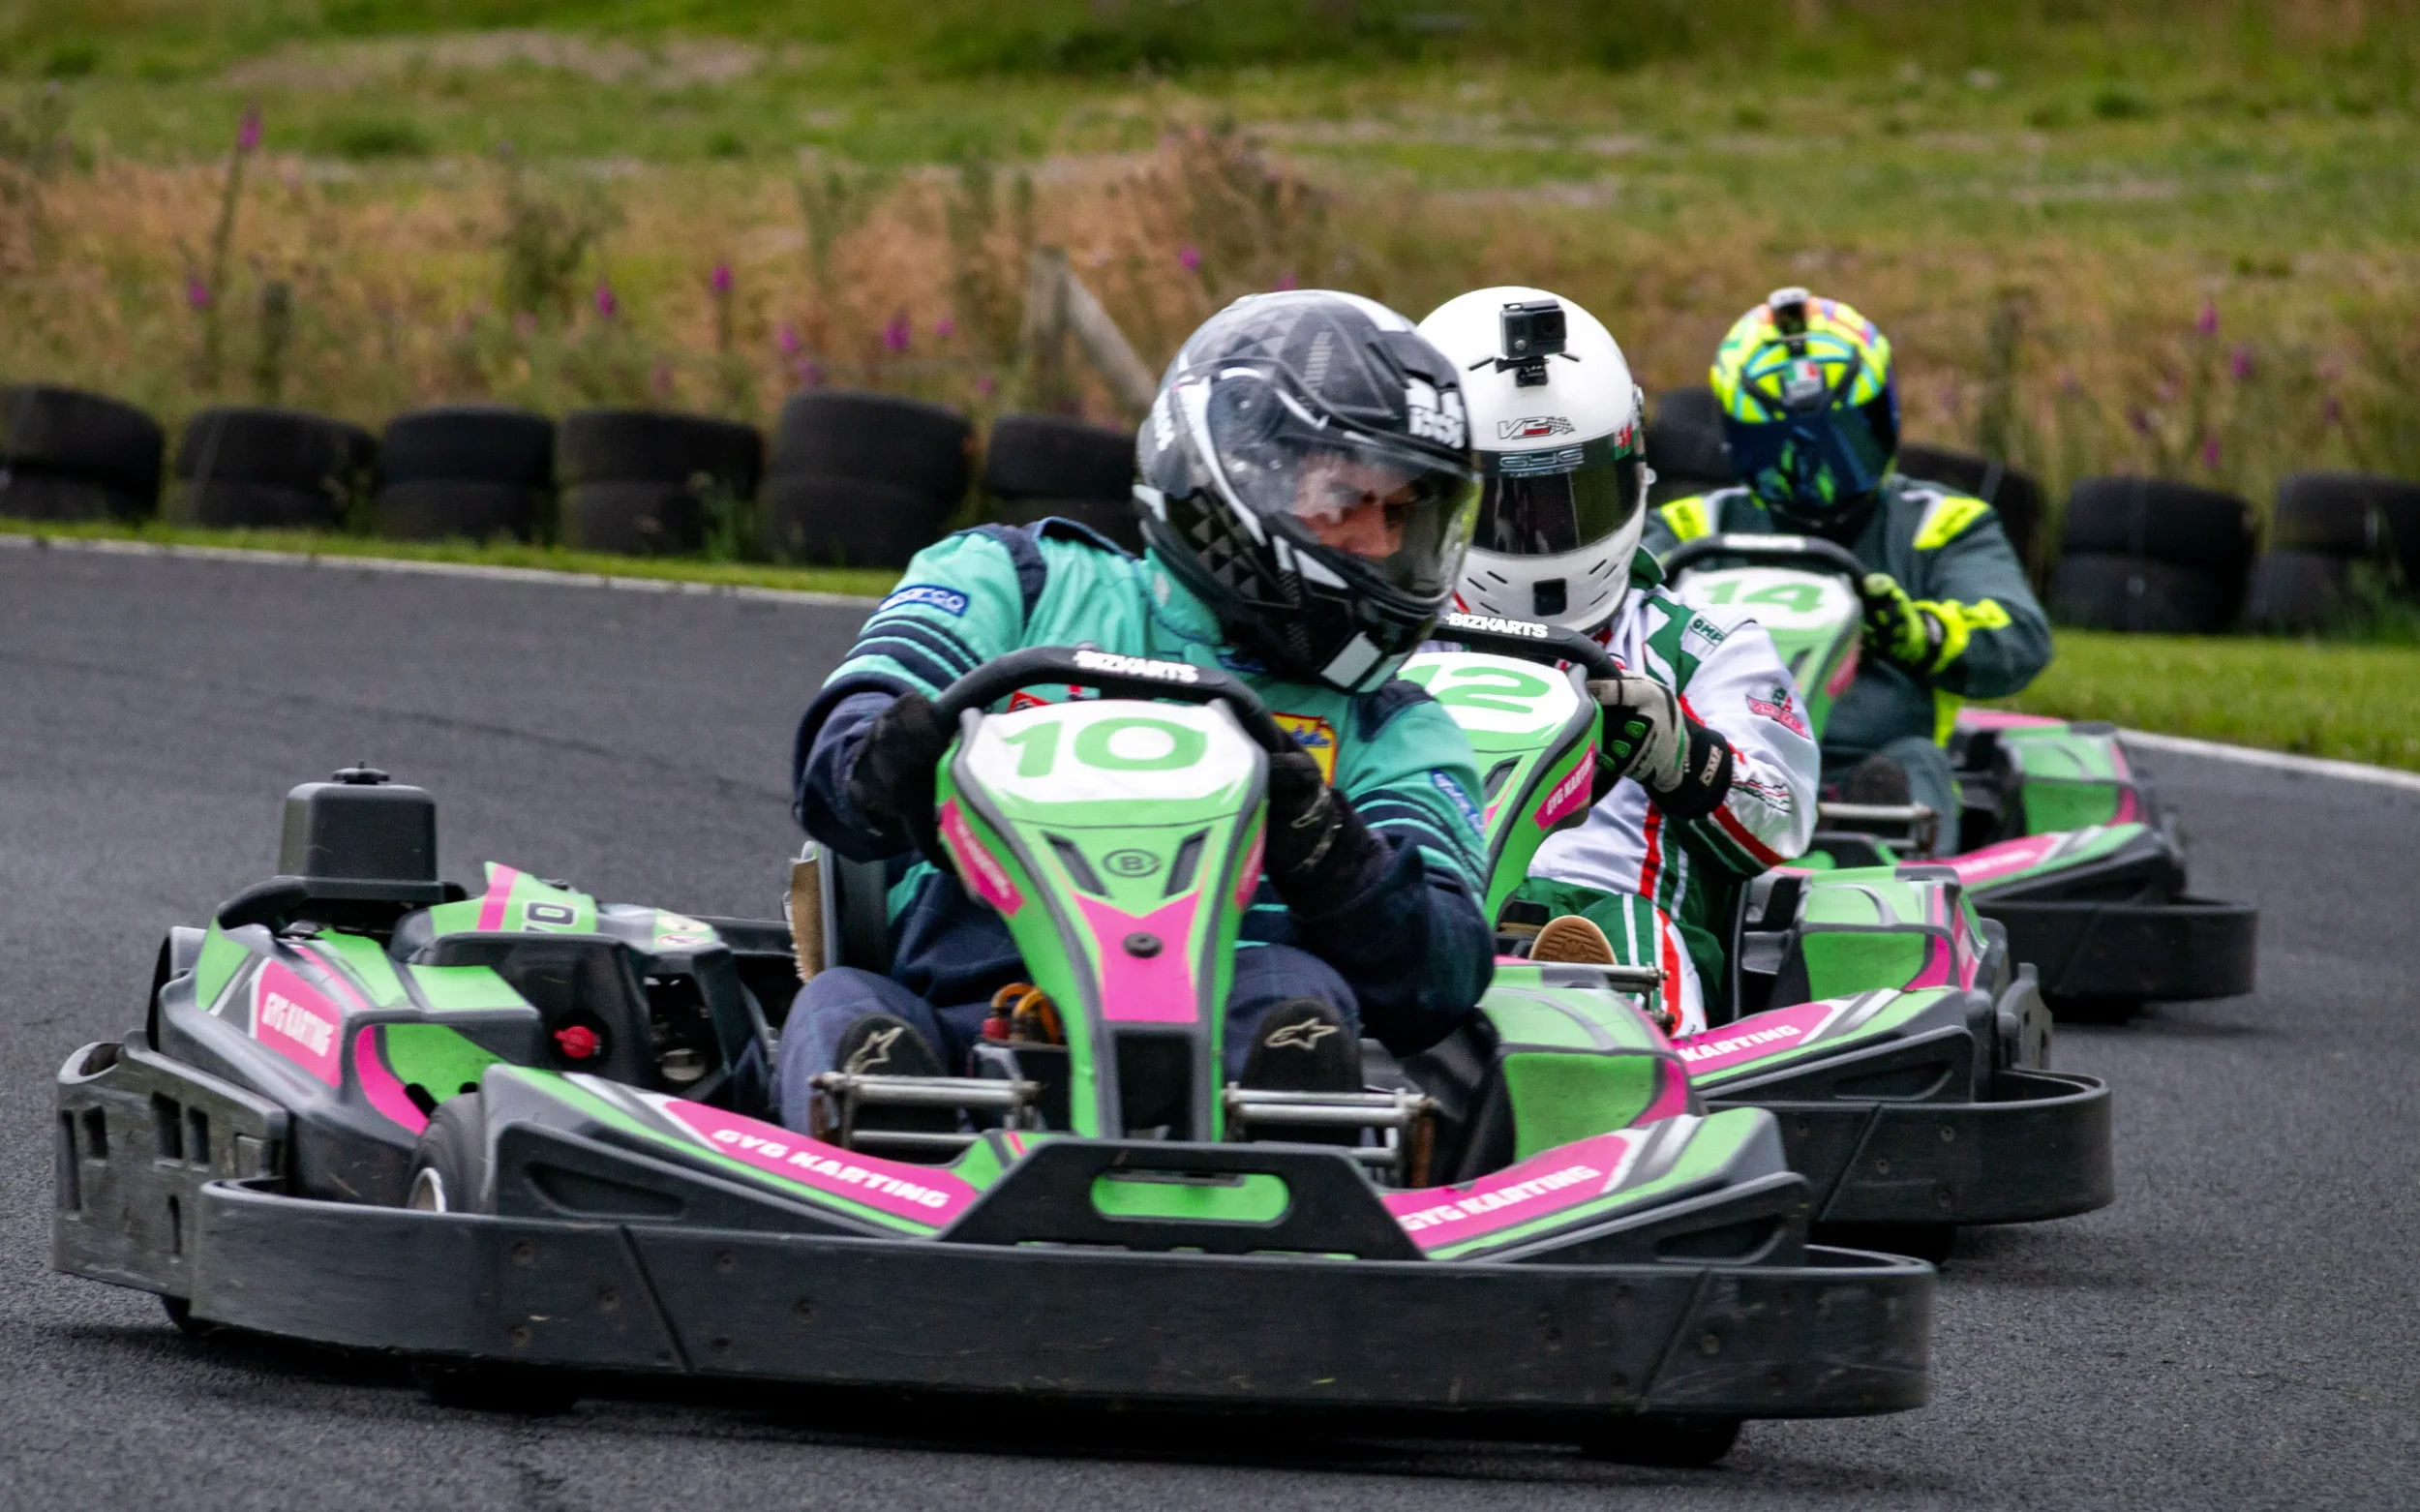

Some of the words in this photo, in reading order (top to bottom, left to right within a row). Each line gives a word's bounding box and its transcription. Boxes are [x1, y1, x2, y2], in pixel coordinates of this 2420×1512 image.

[1703, 580, 1825, 613] 14
[1448, 612, 1549, 638] BIZKARTS
[1692, 618, 1724, 642] OMP
[1004, 716, 1208, 778] 10
[1677, 1025, 1801, 1062] KARTING
[711, 1129, 790, 1159] GYG
[787, 1151, 952, 1209] KARTING
[1455, 1164, 1603, 1215] KARTING
